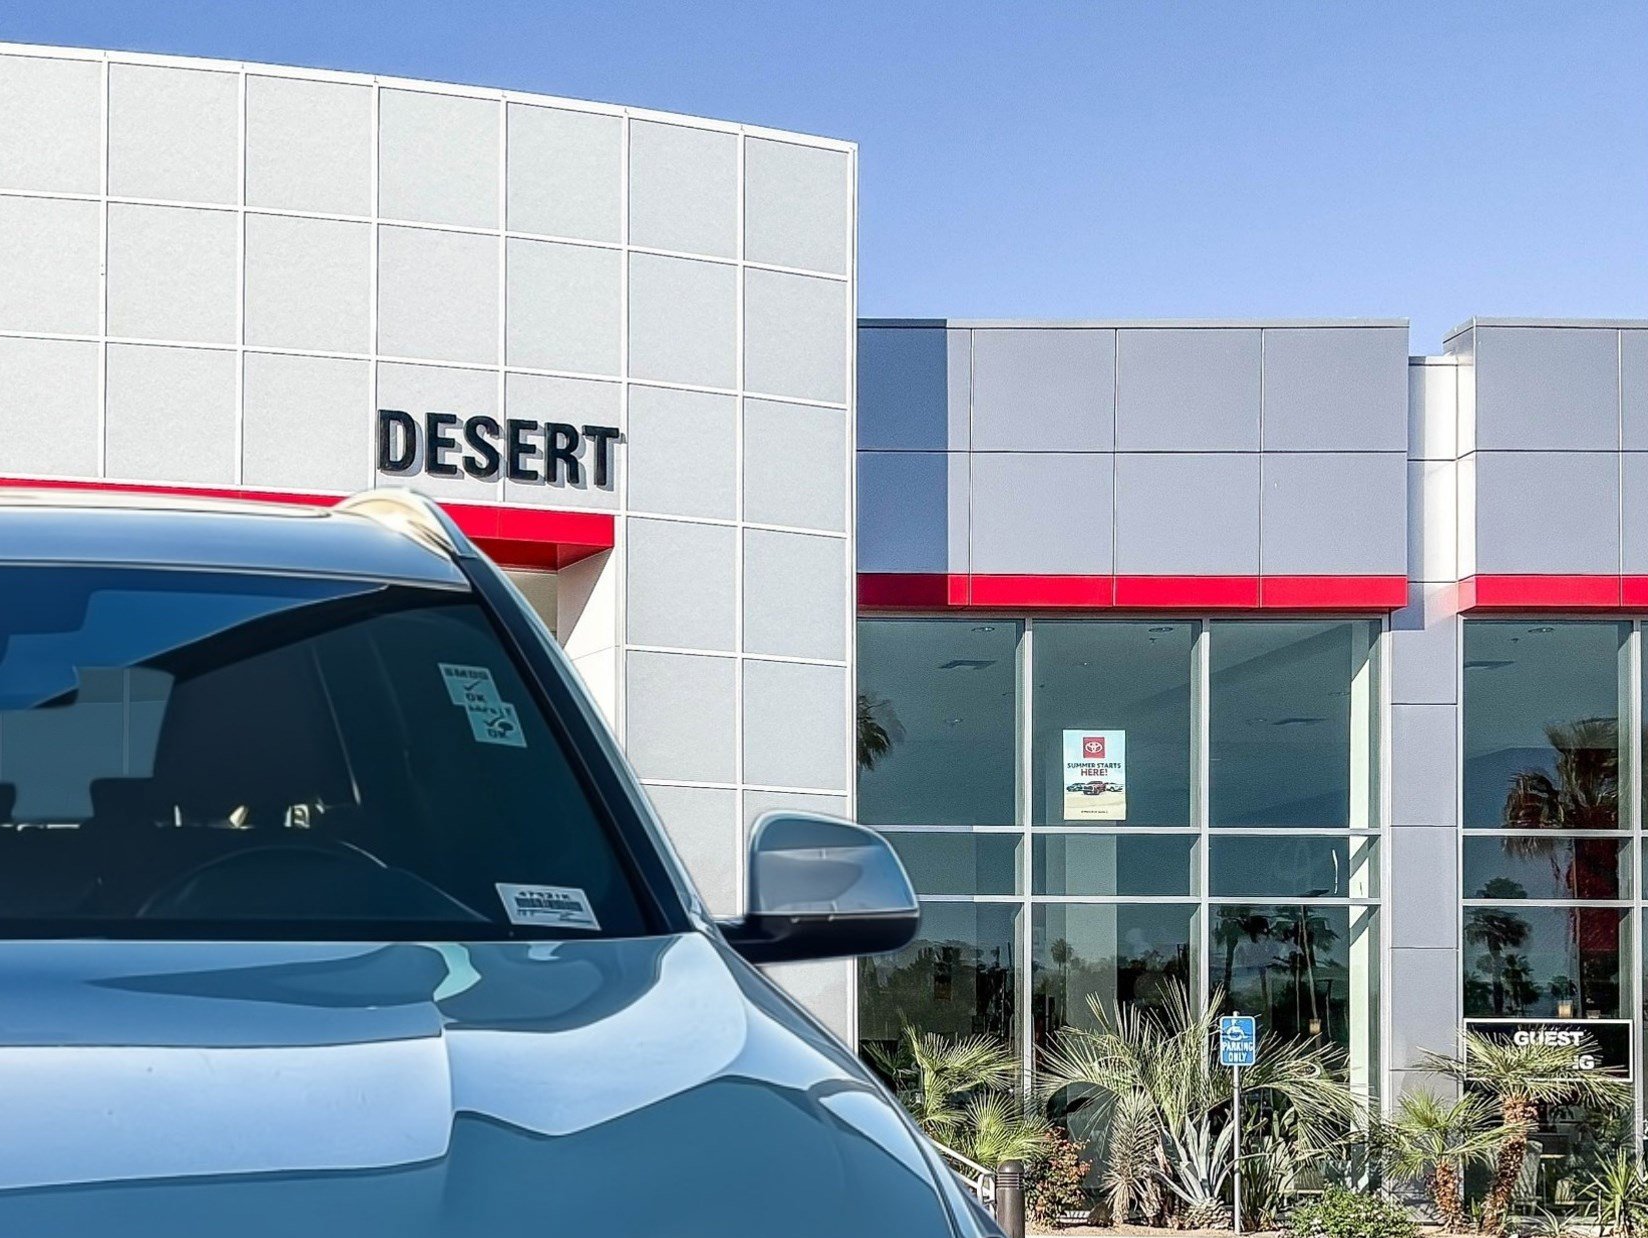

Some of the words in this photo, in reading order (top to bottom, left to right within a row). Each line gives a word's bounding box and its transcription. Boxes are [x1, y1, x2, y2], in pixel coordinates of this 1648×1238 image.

[377, 409, 619, 487] DESERT
[1513, 1031, 1584, 1046] GUEST
[1222, 1042, 1253, 1051] PARKING
[1228, 1052, 1248, 1062] ONLY
